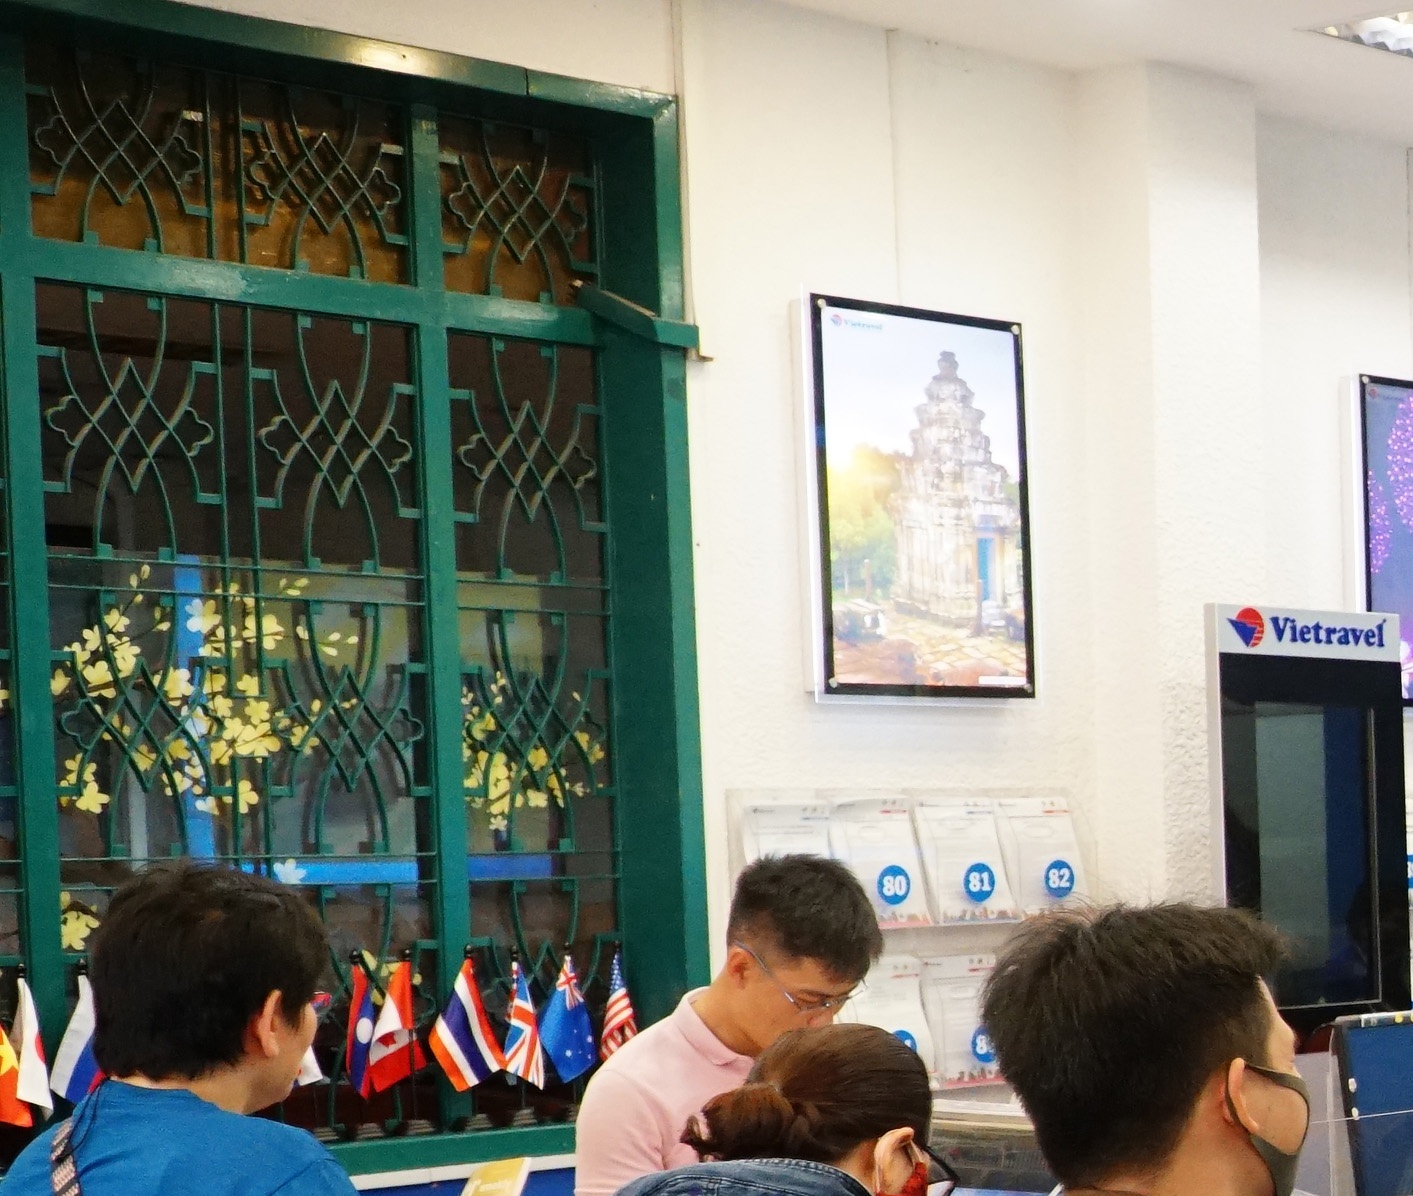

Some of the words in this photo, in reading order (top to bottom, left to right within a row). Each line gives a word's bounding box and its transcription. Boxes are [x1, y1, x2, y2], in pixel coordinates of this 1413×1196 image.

[1269, 616, 1387, 648] Vietravel
[882, 875, 908, 897] 80
[968, 871, 992, 893] 81
[1048, 867, 1071, 889] 82
